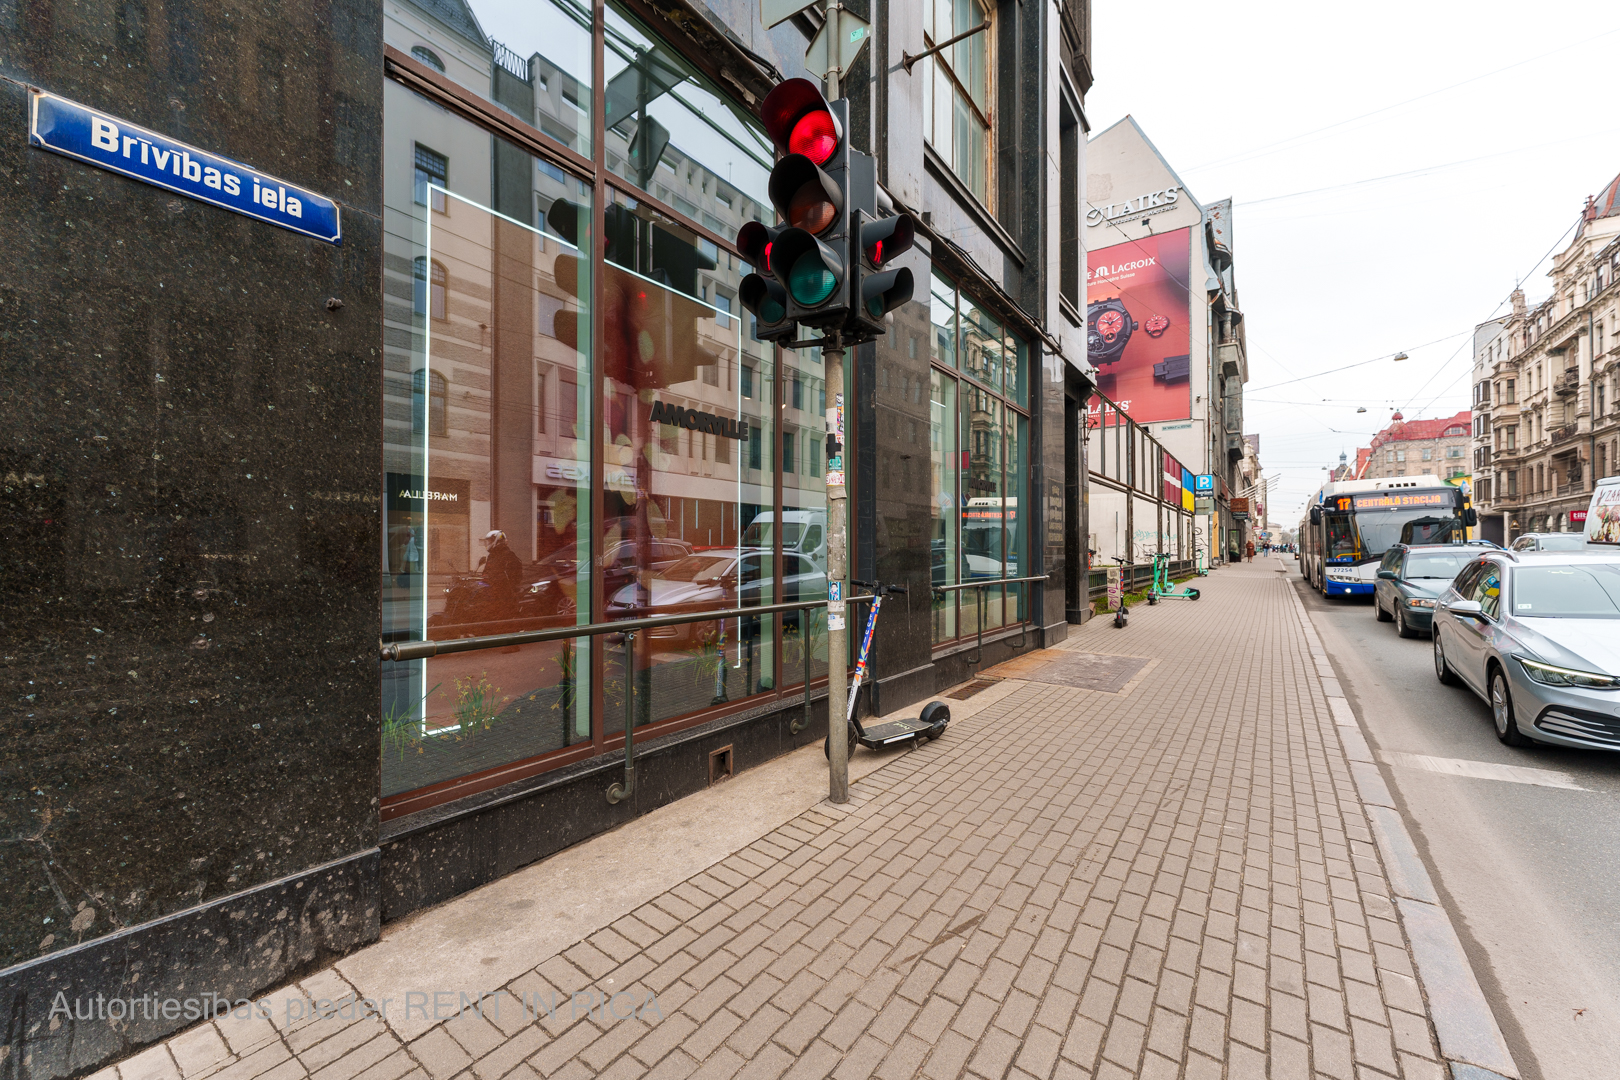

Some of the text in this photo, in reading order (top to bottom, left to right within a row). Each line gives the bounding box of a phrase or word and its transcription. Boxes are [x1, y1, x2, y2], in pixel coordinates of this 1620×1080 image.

[91, 116, 303, 219] Brīvības iela
[1106, 186, 1178, 220] LAIKS
[1111, 257, 1156, 274] LACROIX
[1337, 494, 1442, 511] 17 CENTRĀLĀ STACIJA
